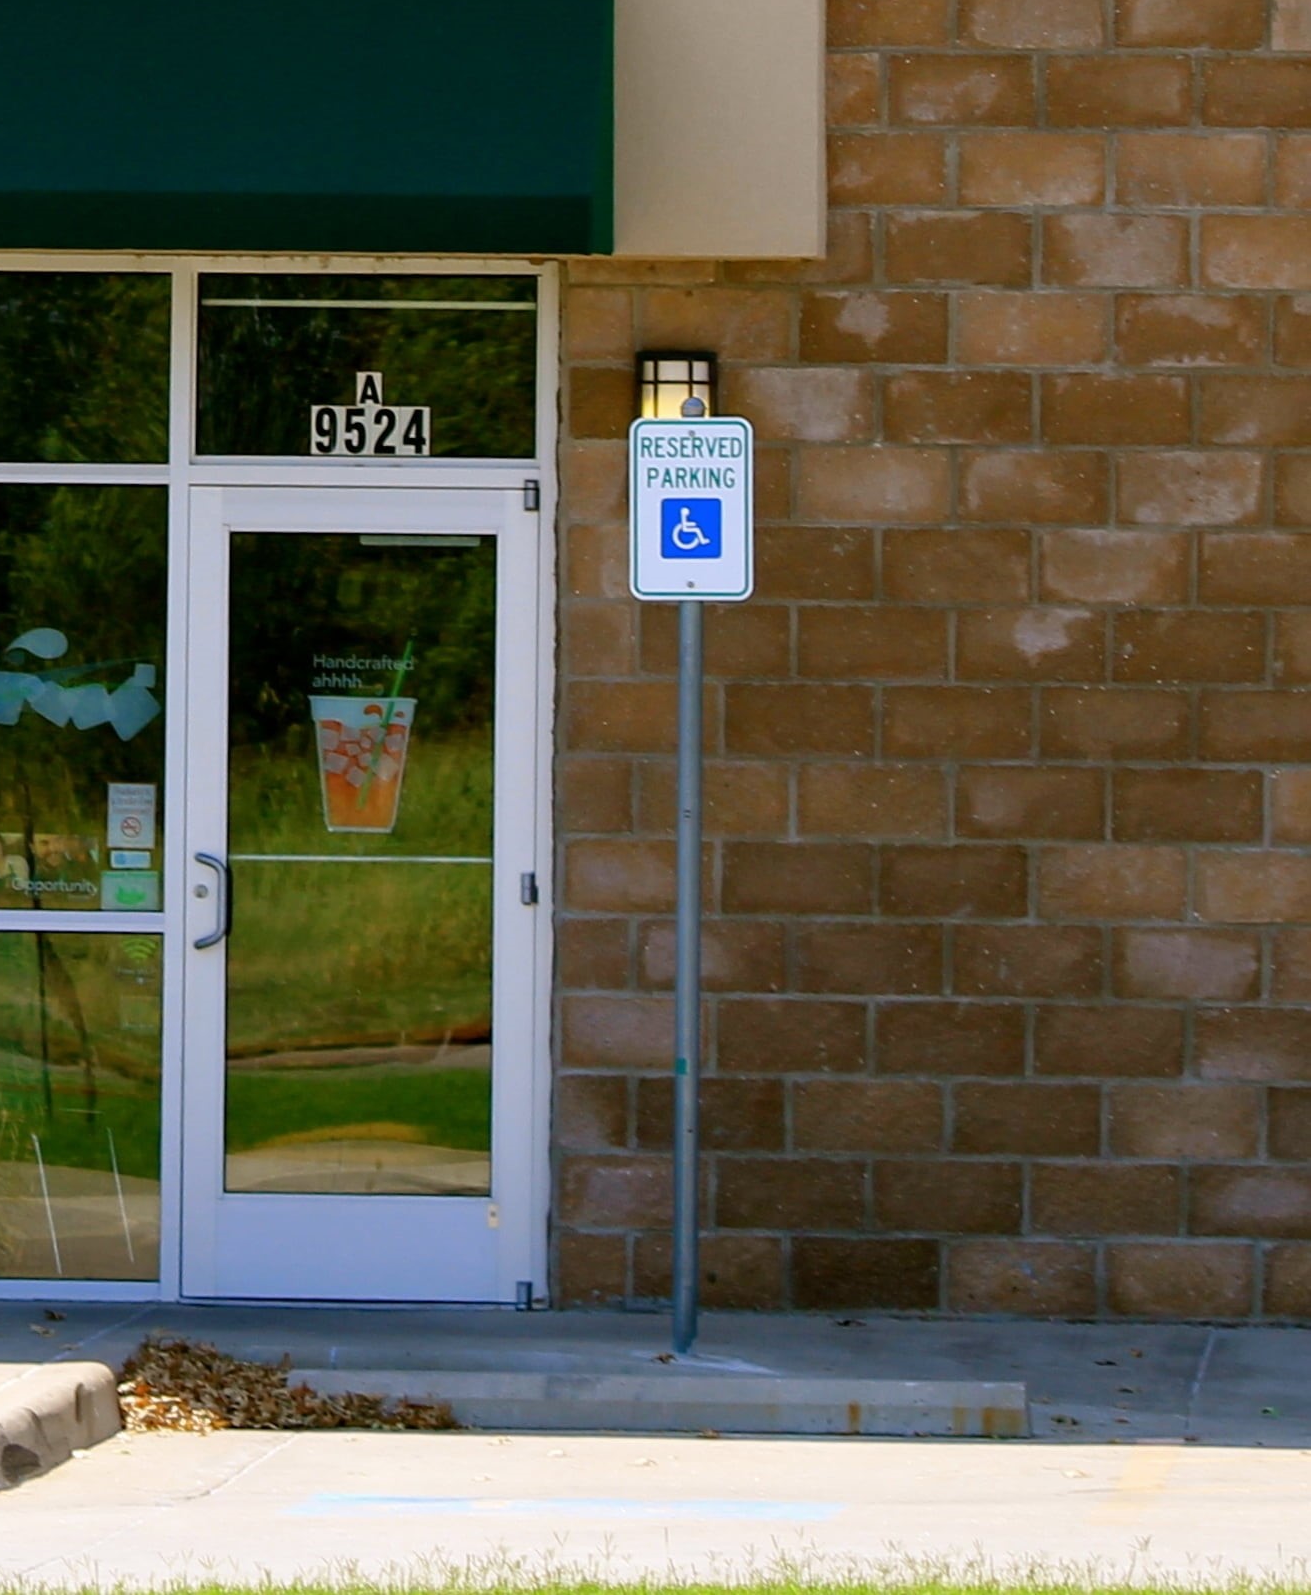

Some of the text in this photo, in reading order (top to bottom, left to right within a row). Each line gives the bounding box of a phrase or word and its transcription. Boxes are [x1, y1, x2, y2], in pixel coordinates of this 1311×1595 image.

[359, 373, 381, 404] A
[314, 406, 427, 455] 9524
[640, 437, 743, 458] RESERVED
[646, 467, 736, 489] PARKING
[312, 653, 415, 671] Handcrafted
[11, 878, 98, 896] Opportunity
